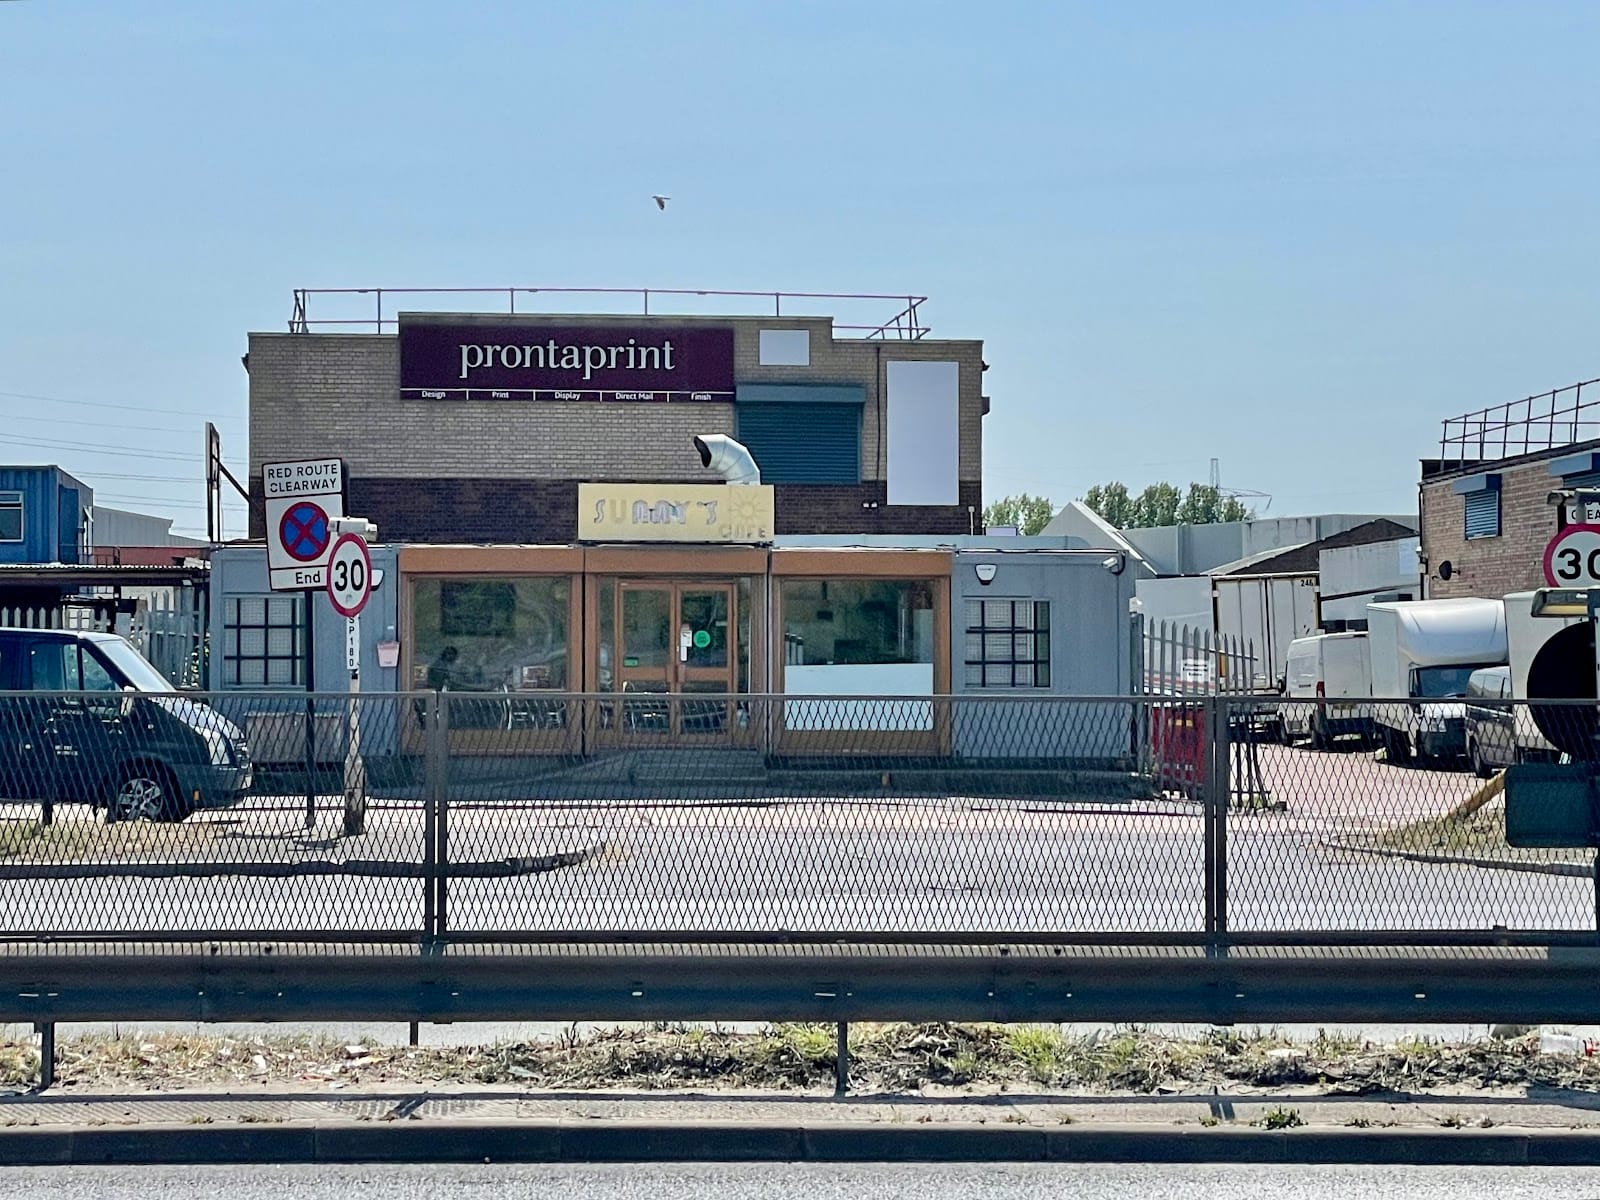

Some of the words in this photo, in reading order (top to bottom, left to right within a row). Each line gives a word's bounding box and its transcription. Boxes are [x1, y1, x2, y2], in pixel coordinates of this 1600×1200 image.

[459, 338, 675, 380] prontaprint
[421, 390, 446, 400] Design
[491, 391, 510, 399] Print
[554, 391, 581, 400] Display
[615, 392, 637, 400] Direct
[638, 392, 654, 400] Mail
[691, 392, 712, 400] Finish
[267, 468, 292, 479] RED
[296, 463, 338, 476] ROUTE
[269, 477, 337, 493] CLEARWAY
[295, 571, 321, 584] End
[334, 559, 364, 591] 30
